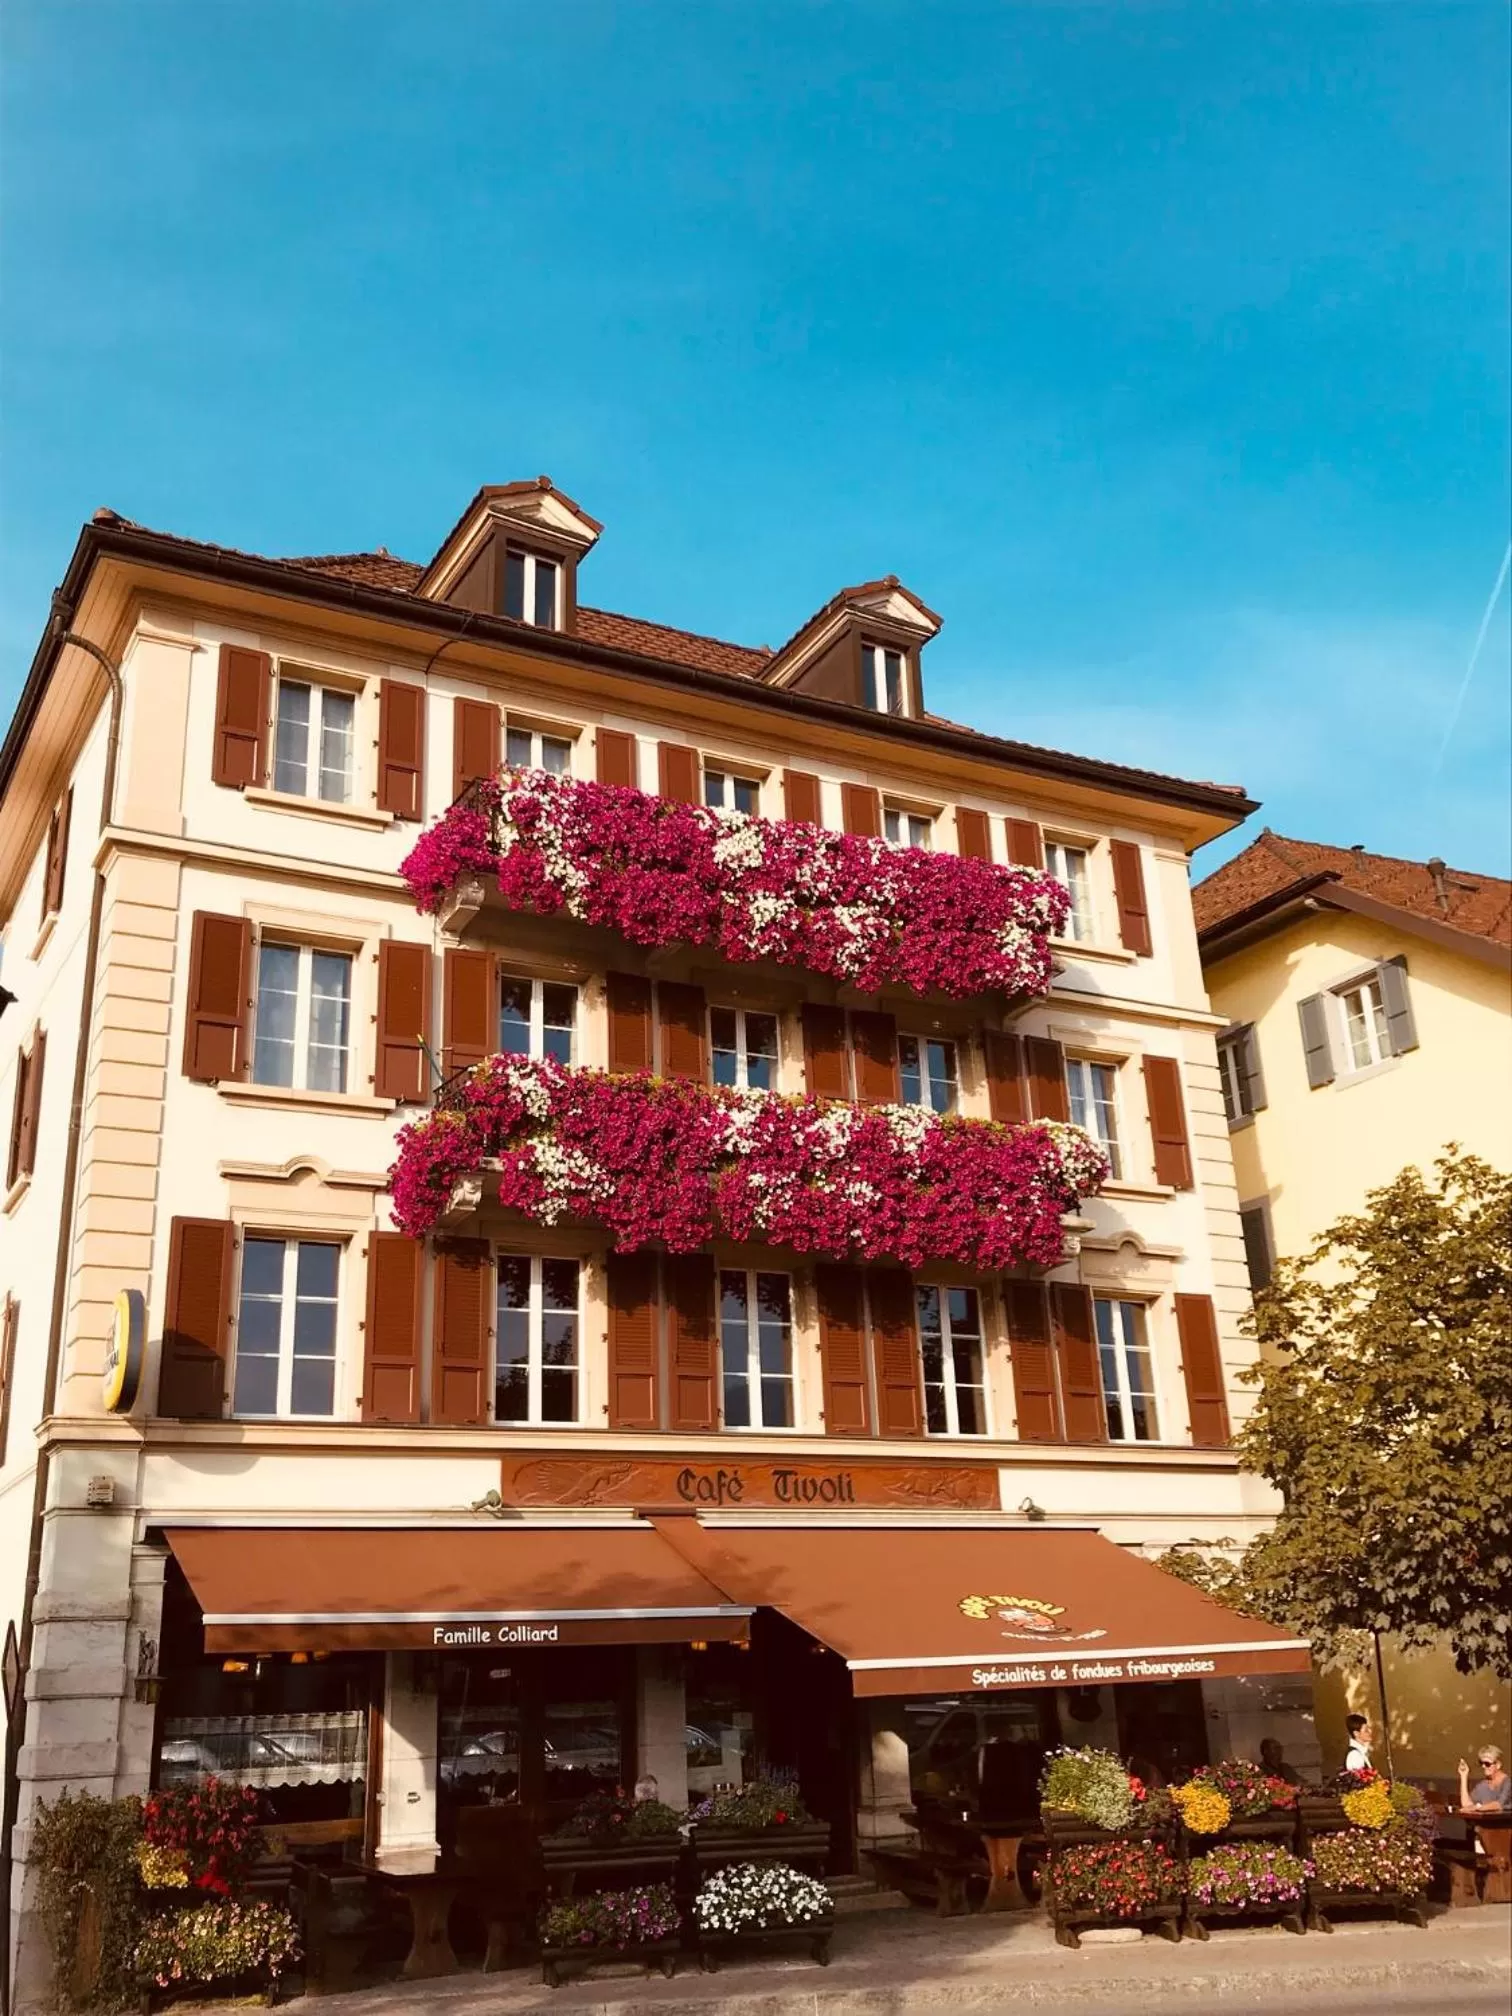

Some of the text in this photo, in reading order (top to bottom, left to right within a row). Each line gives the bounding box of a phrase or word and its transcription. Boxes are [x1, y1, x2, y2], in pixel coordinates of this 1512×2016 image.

[677, 1468, 856, 1505] Café Tivoli
[433, 1625, 558, 1644] Famille Colliard
[972, 1658, 1215, 1688] Spécialités de fondues fribourgeoises
